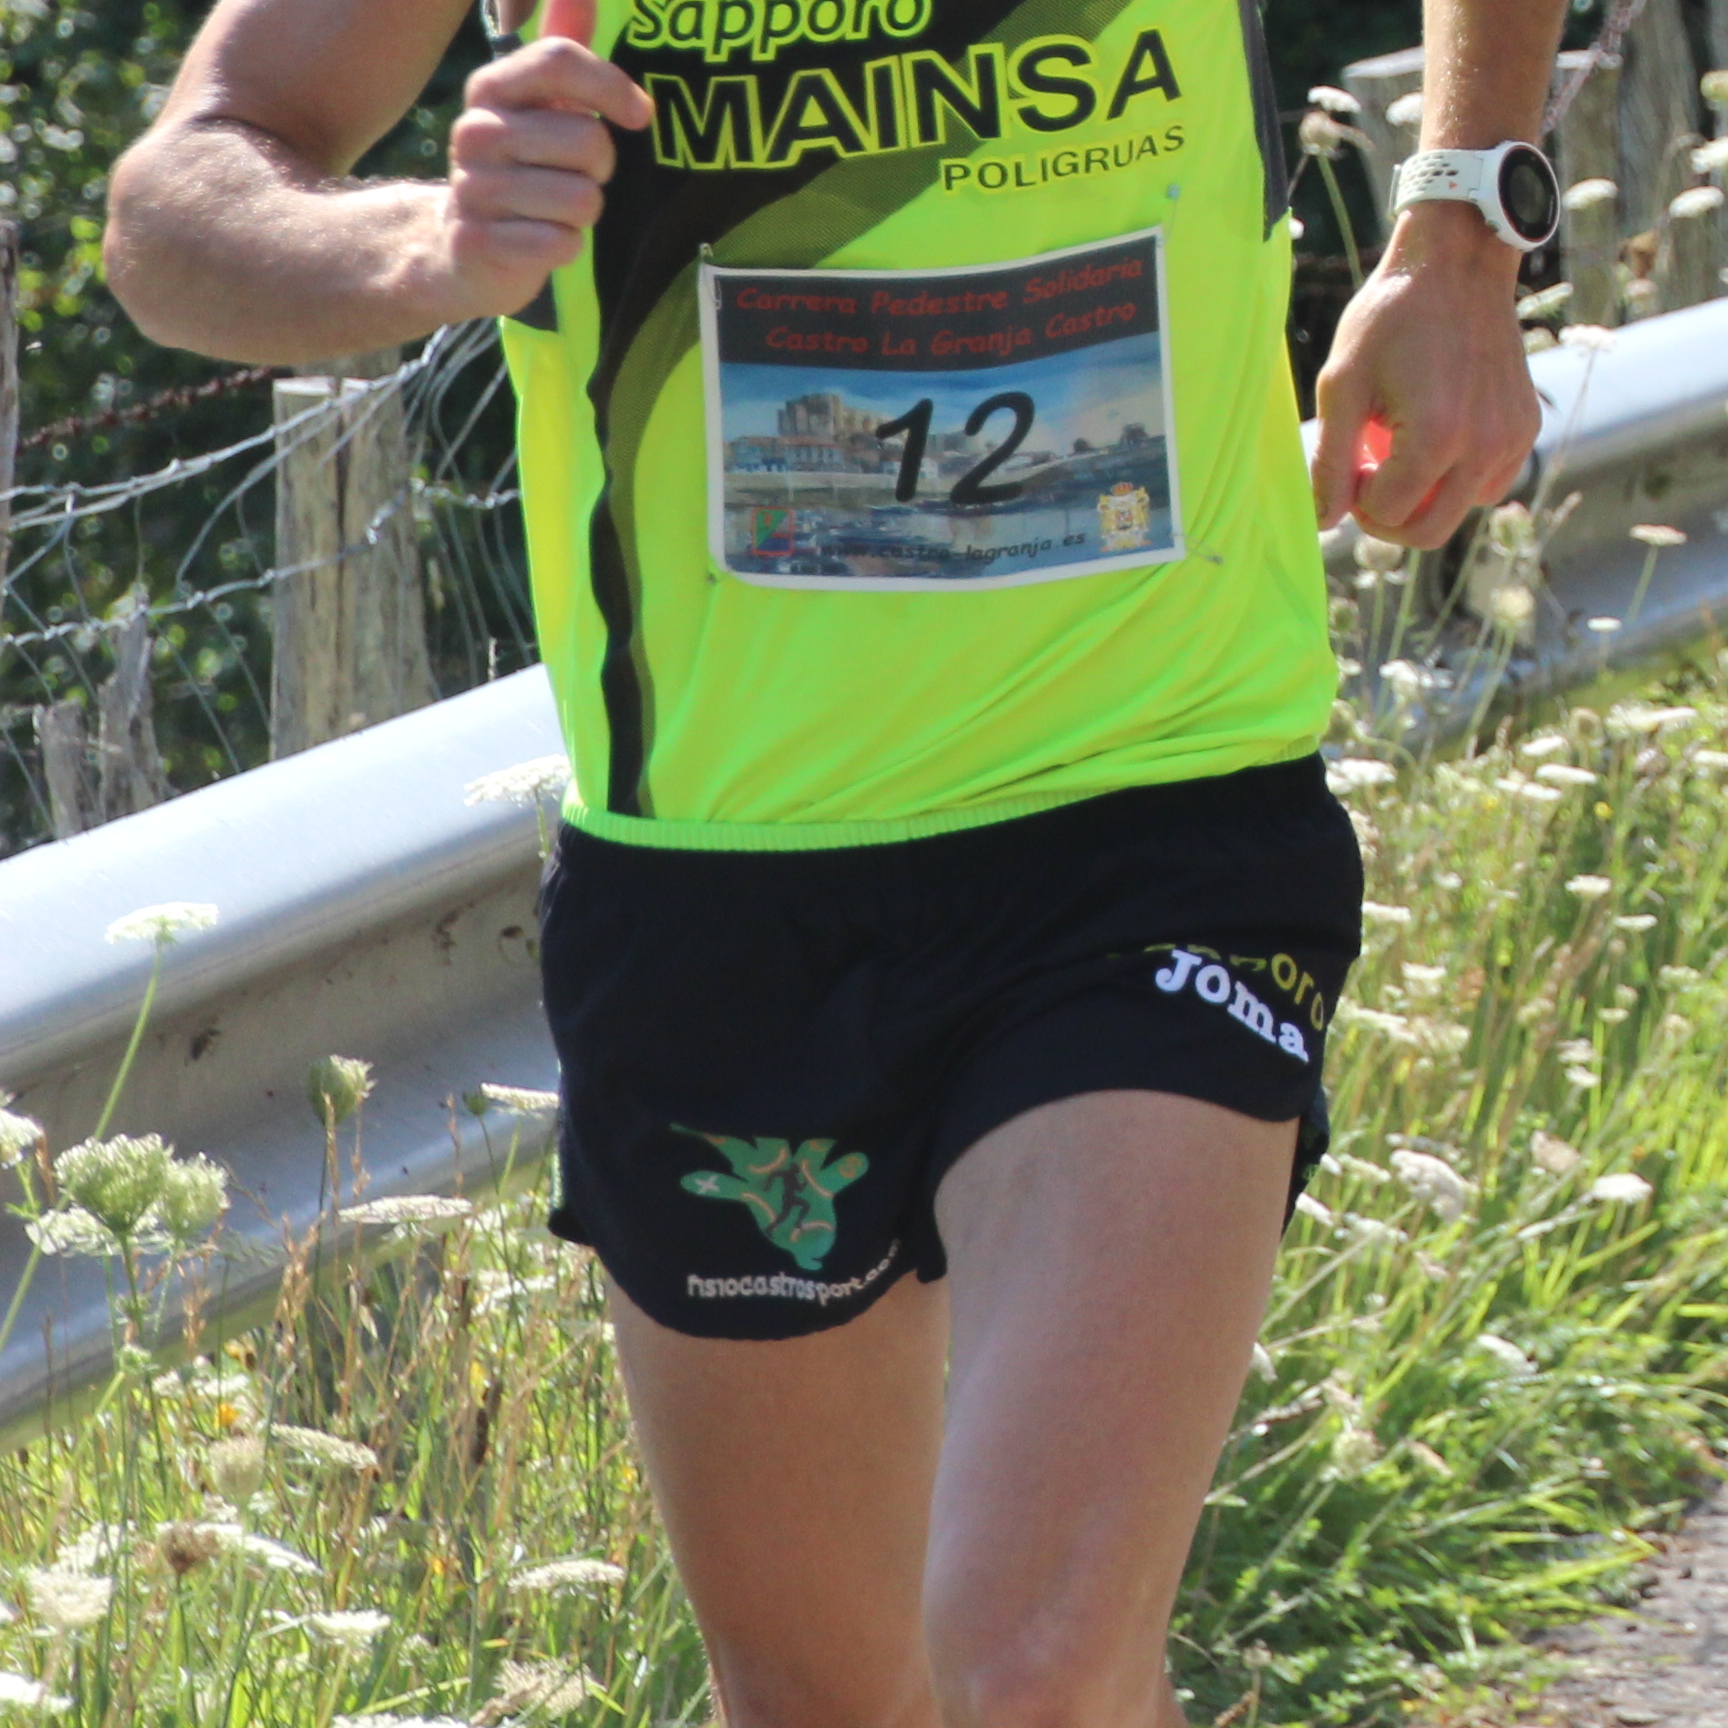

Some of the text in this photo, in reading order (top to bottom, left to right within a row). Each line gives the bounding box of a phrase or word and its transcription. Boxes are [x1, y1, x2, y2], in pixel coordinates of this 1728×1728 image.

[648, 28, 1184, 169] MAINSA
[944, 125, 1186, 193] POLIGRUAS
[736, 257, 1143, 315] Carrera Pedestre Solidaria
[765, 302, 1137, 357] Castro La Granja Castro
[875, 391, 1036, 504] 12
[1154, 948, 1309, 1063] Joma
